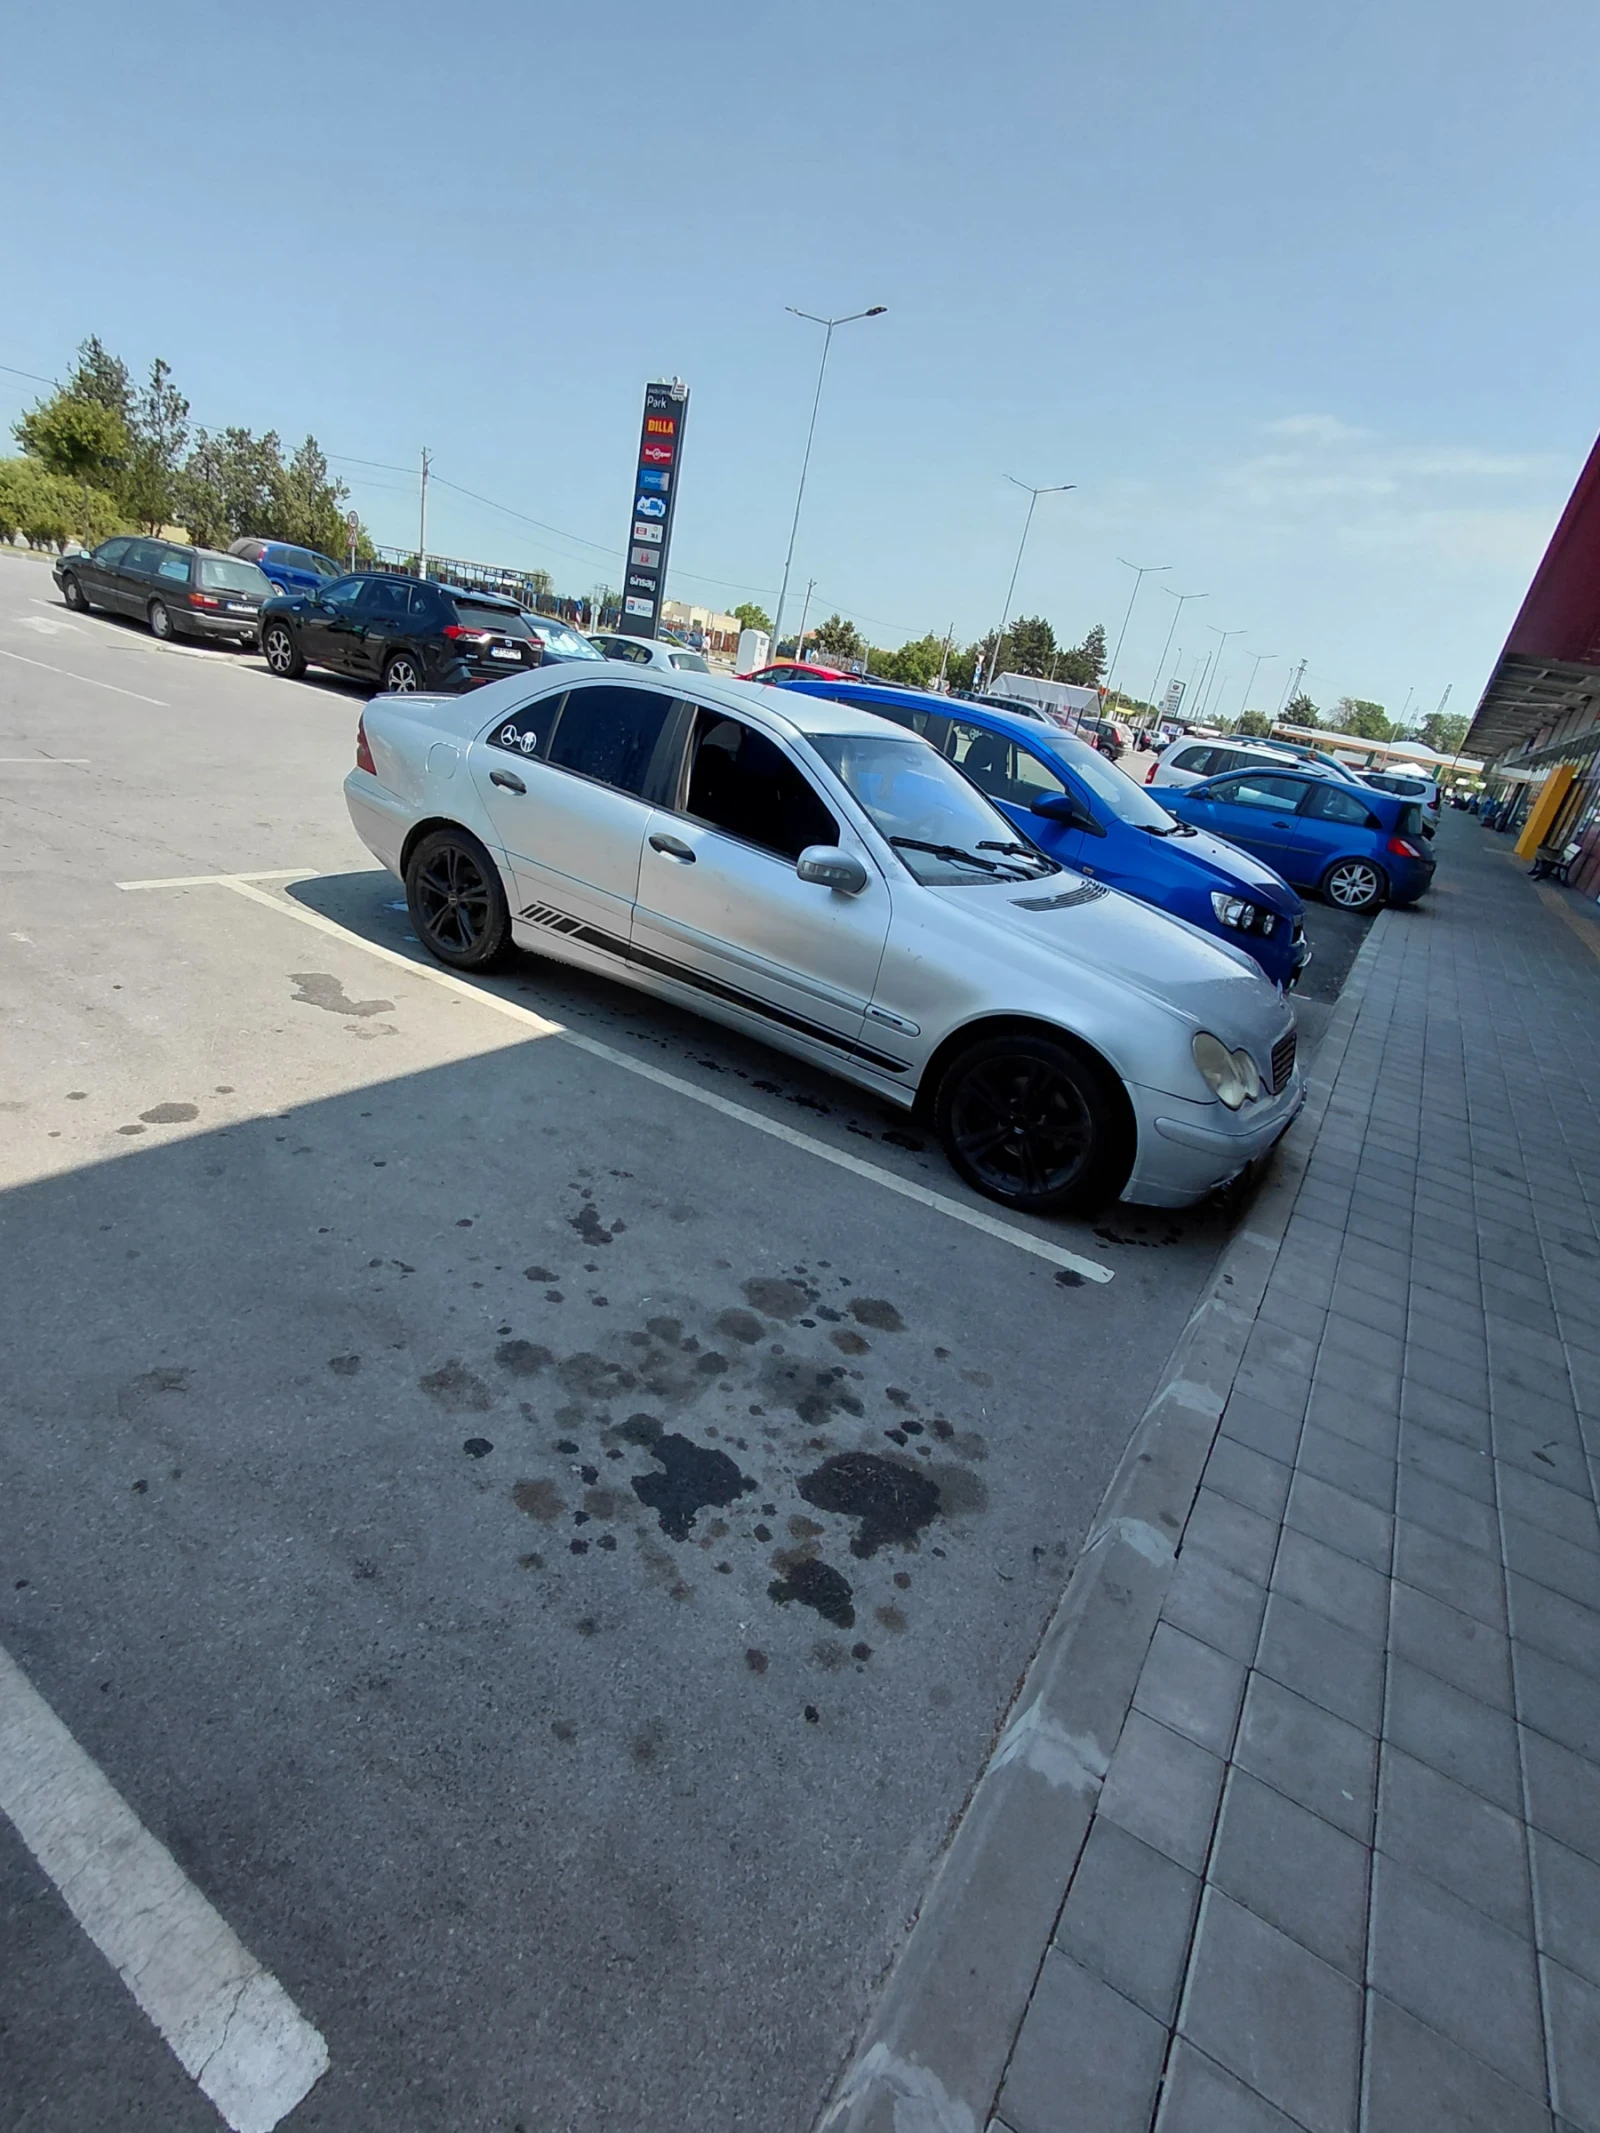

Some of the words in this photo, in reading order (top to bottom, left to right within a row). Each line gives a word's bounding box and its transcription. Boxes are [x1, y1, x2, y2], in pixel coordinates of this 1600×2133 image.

[647, 395, 667, 409] Park
[647, 419, 674, 434] BILLA
[629, 574, 656, 592] sinsay
